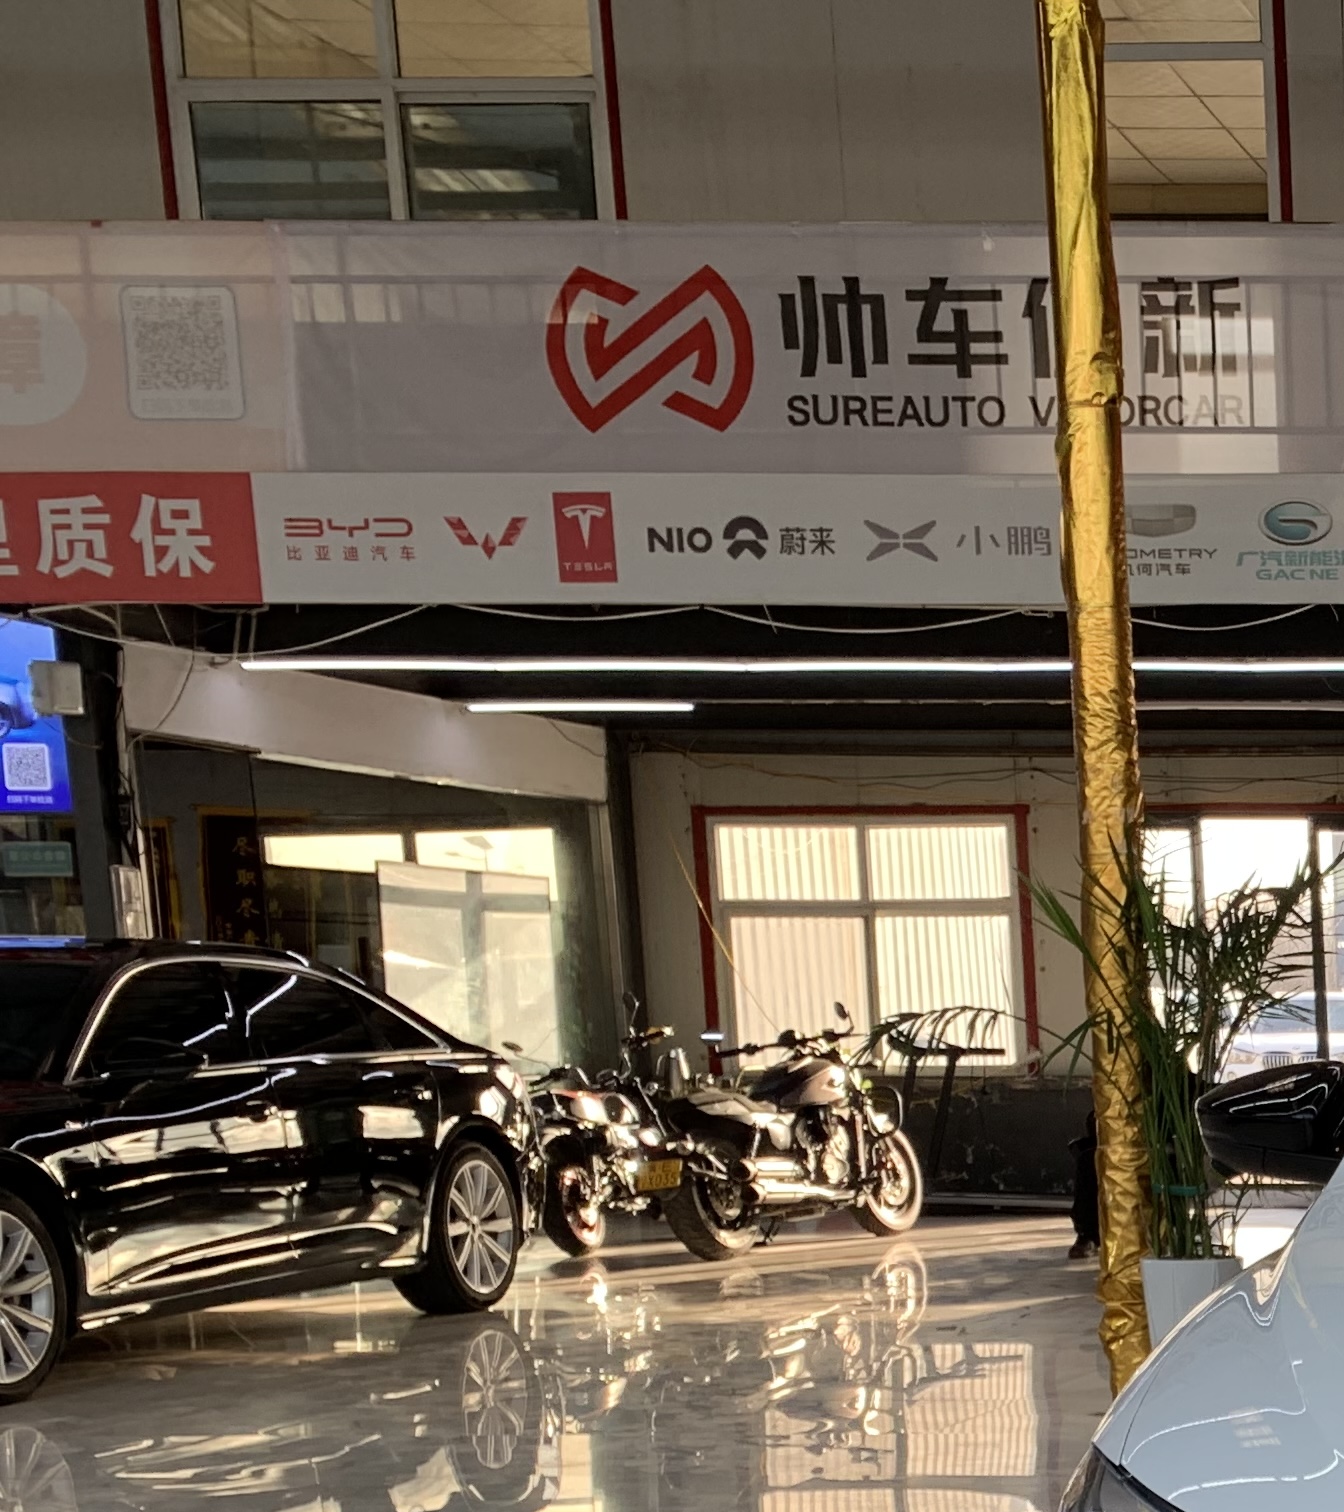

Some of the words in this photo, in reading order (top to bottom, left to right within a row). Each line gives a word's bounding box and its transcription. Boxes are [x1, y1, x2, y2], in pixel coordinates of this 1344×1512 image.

[778, 276, 1241, 378] 帅车新
[787, 394, 1006, 428] SUREAUTO
[0, 494, 215, 578] 质保
[284, 517, 413, 538] BYD
[646, 527, 713, 554] NIO
[778, 526, 836, 556] 蔚来
[956, 525, 1052, 556] 小鹏
[286, 545, 416, 561] 比亚迪汽车
[563, 561, 613, 571] TESLA
[1127, 548, 1217, 559] OMETRY
